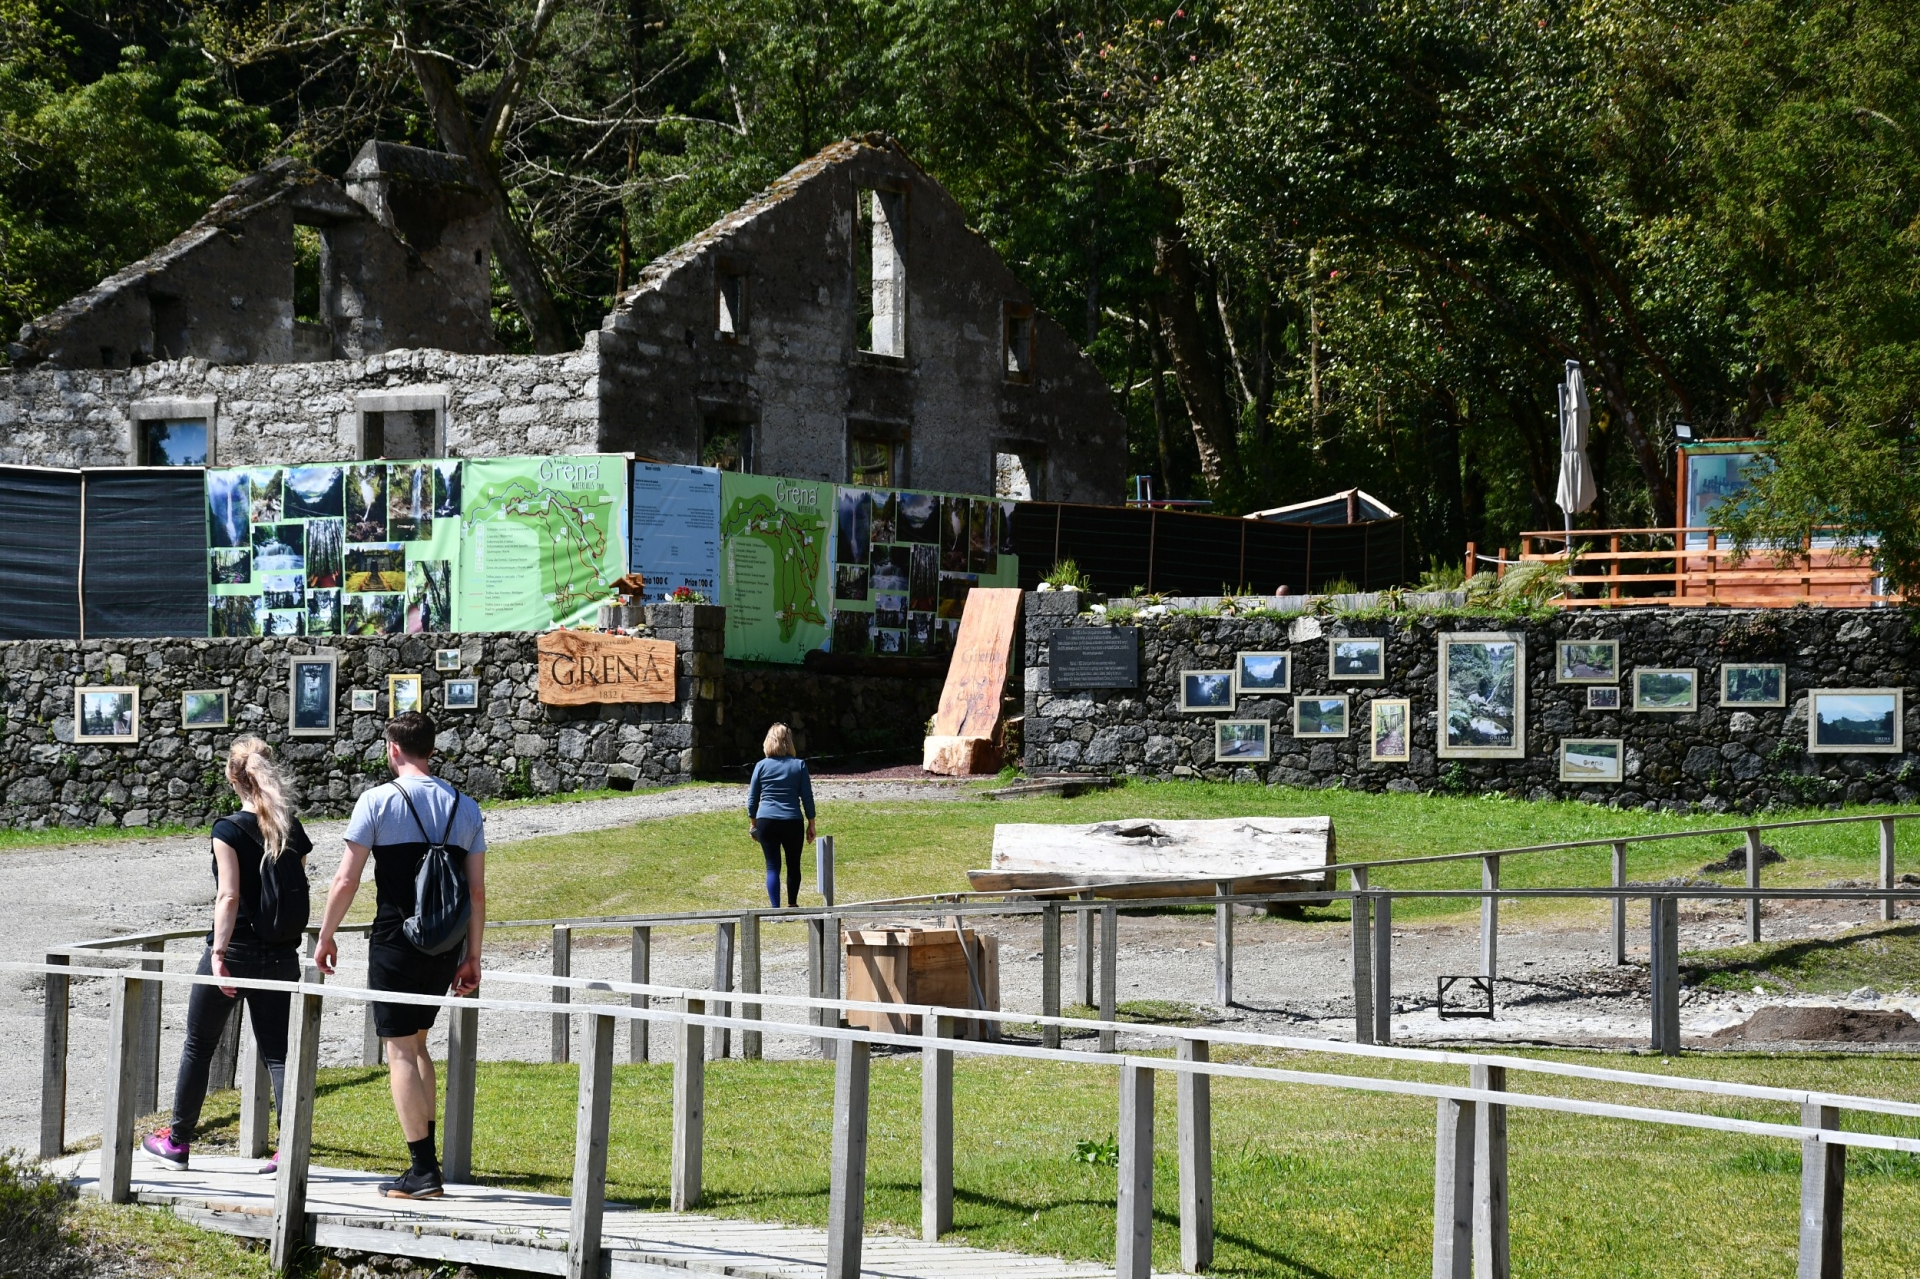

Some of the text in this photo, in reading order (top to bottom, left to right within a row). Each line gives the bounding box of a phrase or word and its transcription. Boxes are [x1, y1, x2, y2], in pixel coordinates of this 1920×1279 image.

[539, 459, 600, 481] Grená
[653, 576, 663, 585] 100
[664, 576, 668, 585] €
[685, 578, 697, 587] Prize
[551, 646, 663, 686] GRENÁ
[599, 690, 618, 699] 1832
